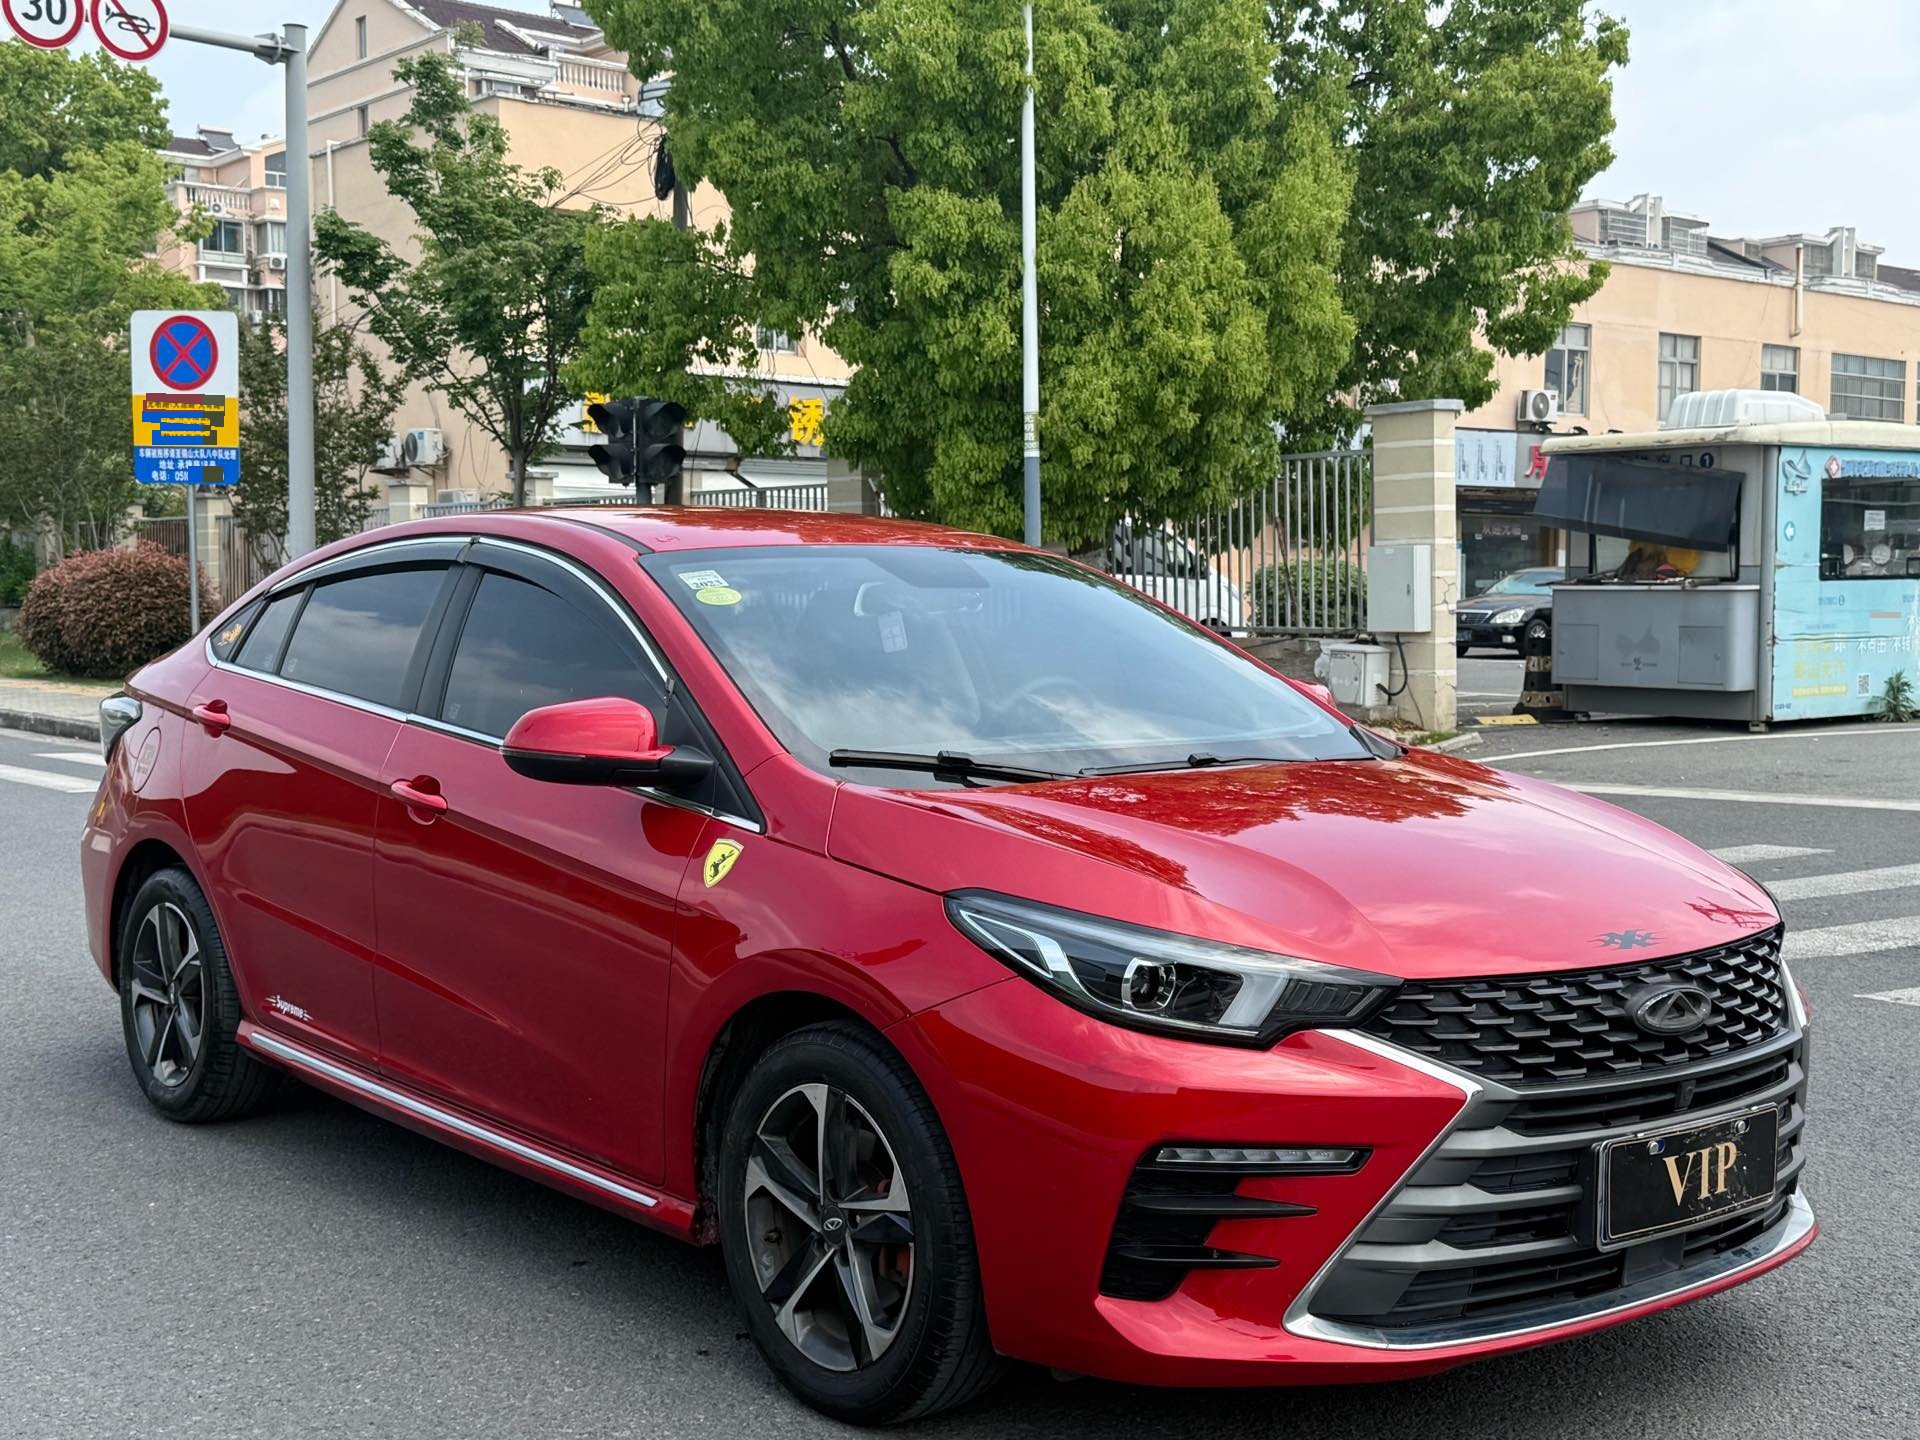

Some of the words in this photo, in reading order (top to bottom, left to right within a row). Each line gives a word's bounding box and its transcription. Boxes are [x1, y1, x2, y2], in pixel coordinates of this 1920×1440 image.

[21, 0, 66, 25] 30
[276, 995, 304, 1018] Supreme
[1663, 1142, 1737, 1207] VIP
